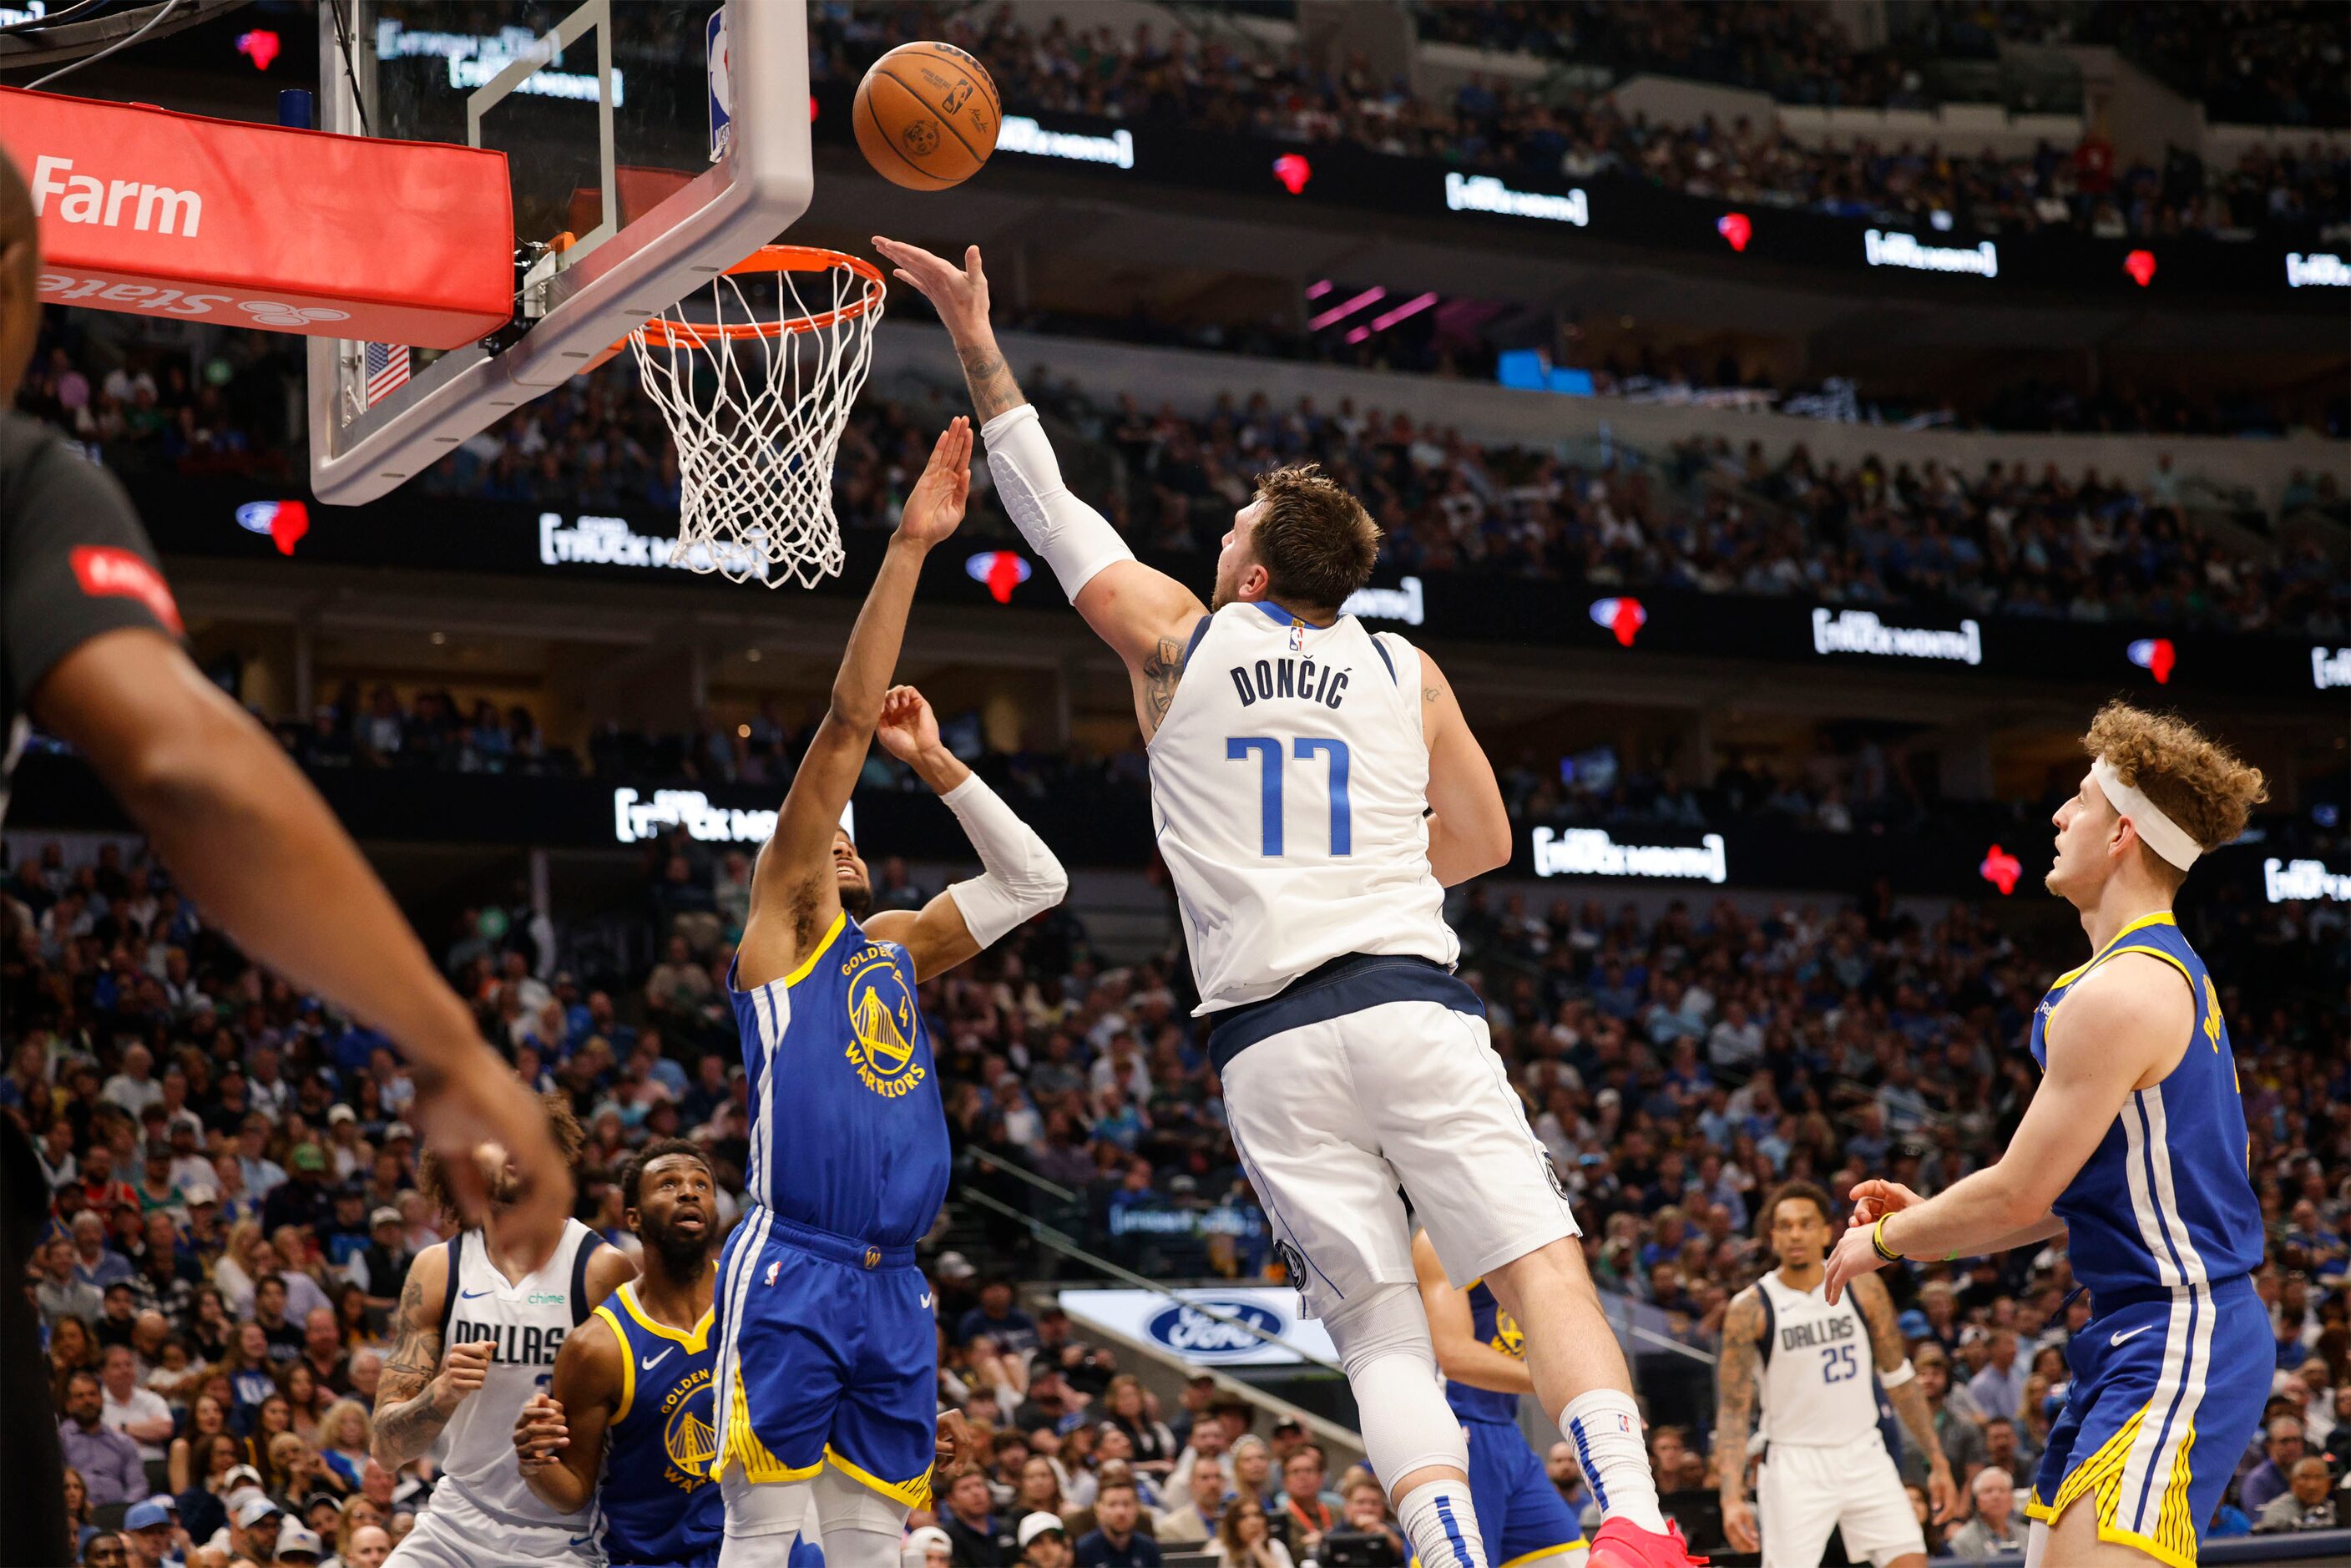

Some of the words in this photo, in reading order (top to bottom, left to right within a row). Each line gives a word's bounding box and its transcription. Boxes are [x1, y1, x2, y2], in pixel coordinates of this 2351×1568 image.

[30, 154, 202, 238] Farm
[39, 274, 234, 315] State
[1230, 655, 1352, 710] DONČIĆ
[1225, 736, 1352, 858] 77
[898, 996, 909, 1027] 4
[845, 1040, 926, 1098] WARRIORS
[528, 1292, 565, 1304] chime
[456, 1320, 564, 1364] DALLAS
[1781, 1315, 1854, 1351] DALLAS
[1821, 1344, 1857, 1383] 25
[660, 1368, 710, 1414] GOLDEN
